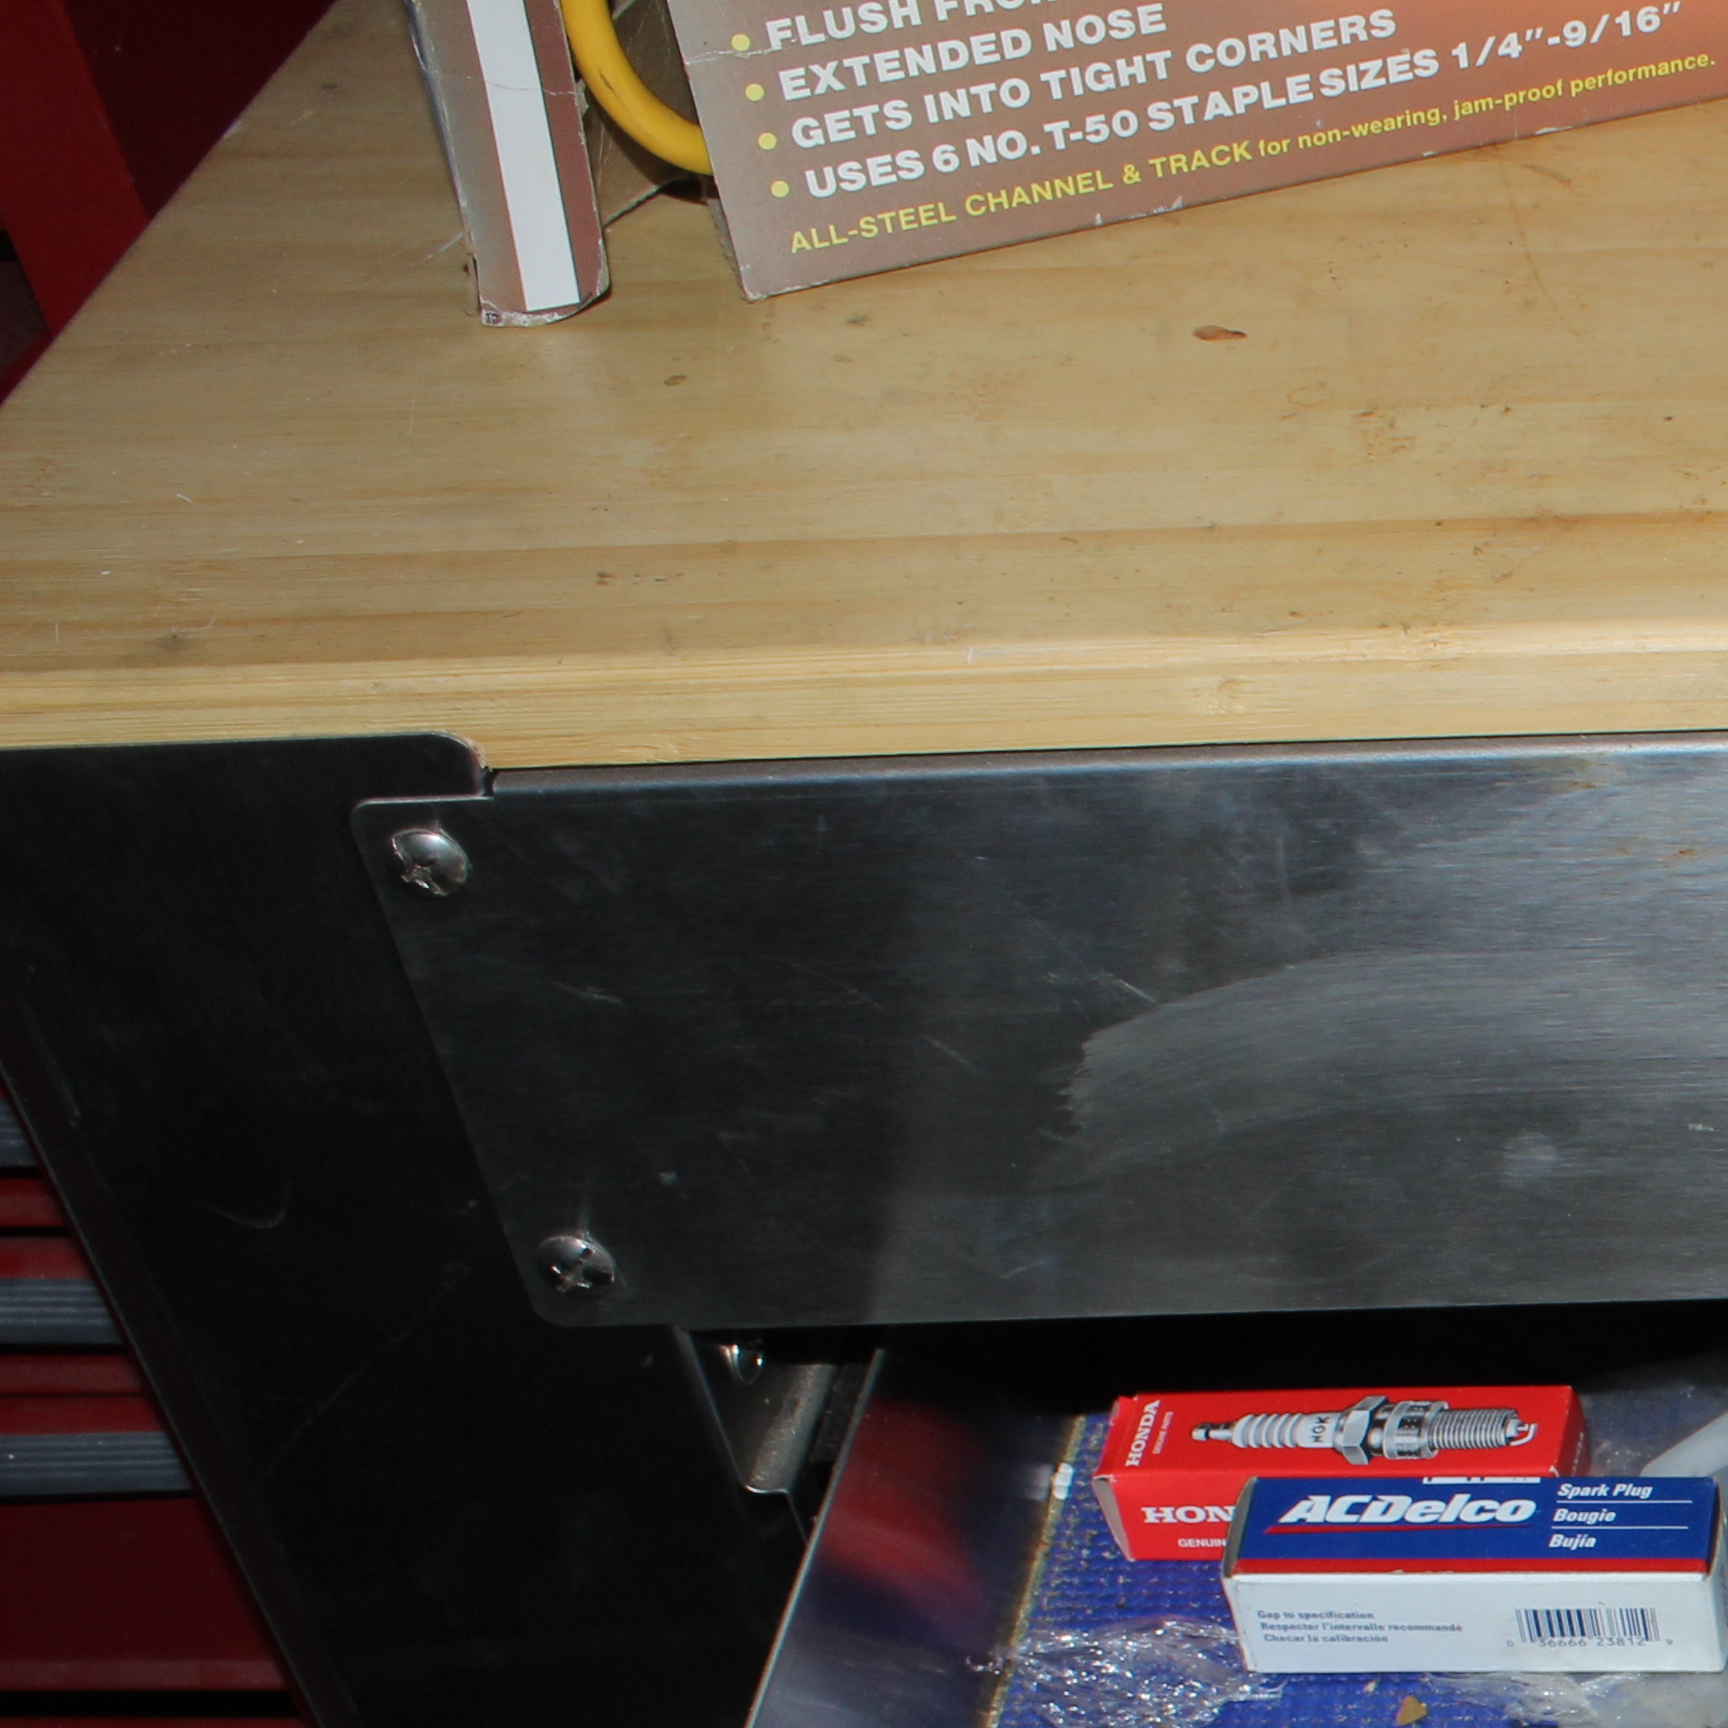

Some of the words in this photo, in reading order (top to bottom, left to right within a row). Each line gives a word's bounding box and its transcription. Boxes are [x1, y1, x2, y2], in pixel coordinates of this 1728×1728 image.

[765, 0, 922, 50] FLUSH
[778, 29, 1031, 100] EXTENDED
[1043, 3, 1167, 52] NOSE
[791, 99, 914, 150] GETS
[924, 78, 1031, 124] INTO
[1040, 50, 1173, 100] TIGHT
[1185, 9, 1397, 75] CORNERS
[805, 149, 926, 198] USES
[932, 144, 960, 174] 6
[965, 130, 1041, 168] NO.
[1044, 110, 1139, 151] T-50
[1147, 73, 1313, 132] STAPLE
[1319, 48, 1440, 97] SIZES
[790, 202, 957, 253] ALL-STEEL
[964, 171, 1113, 217] CHANNEL
[1122, 164, 1142, 186] &
[1148, 142, 1253, 181] TRACK
[1258, 136, 1290, 158] for
[1297, 106, 1448, 151] non-wearing,
[1452, 80, 1565, 121] jam-proof
[1569, 51, 1717, 96] performance.
[1125, 1399, 1161, 1468] HONDA
[1310, 1415, 1331, 1444] NGK
[1556, 1483, 1612, 1500] Spark
[1614, 1483, 1654, 1501] Plug
[1142, 1505, 1236, 1524] HON
[1278, 1493, 1538, 1525] ACDelco
[1552, 1508, 1617, 1526] Bougie
[1177, 1537, 1228, 1549] GENUIN
[1548, 1532, 1598, 1552] Bujía
[1257, 1610, 1281, 1621] Gap
[1284, 1610, 1295, 1619] to
[1297, 1610, 1375, 1621] specification
[1260, 1622, 1320, 1633] Respecter
[1538, 1636, 1588, 1648] 36666
[1596, 1636, 1647, 1647] 23812
